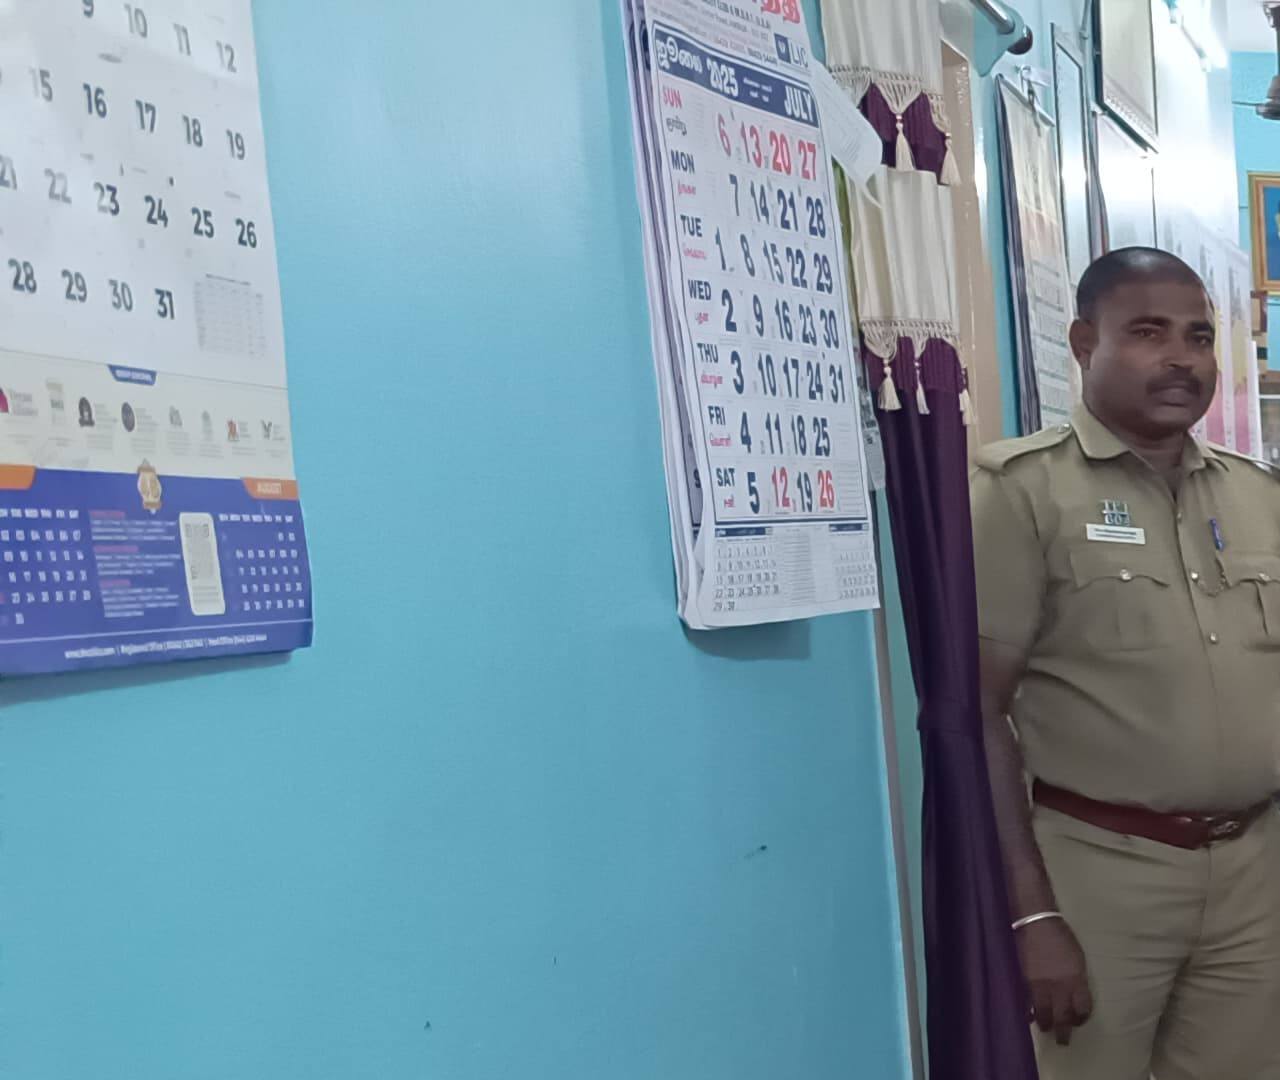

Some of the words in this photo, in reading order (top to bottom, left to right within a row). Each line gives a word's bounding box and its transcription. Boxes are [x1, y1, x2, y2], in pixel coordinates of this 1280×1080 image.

[789, 39, 808, 68] LIC
[83, 83, 107, 119] 16
[136, 100, 156, 134] 17
[183, 115, 202, 149] 18
[226, 128, 245, 160] 19
[707, 60, 738, 98] 2025
[784, 85, 814, 122] JULY
[663, 87, 682, 108] SUN
[718, 113, 731, 157] 6
[741, 121, 762, 168] 13
[770, 129, 792, 176] 20
[798, 140, 817, 181] 27
[680, 215, 703, 238] TUE
[715, 228, 727, 272] 1
[740, 233, 755, 278] 8
[763, 240, 784, 285] 15
[786, 246, 808, 289] 22
[813, 252, 833, 295] 29
[8, 260, 37, 294] 28
[62, 269, 87, 303] 29
[109, 279, 133, 312] 30
[155, 288, 175, 320] 31
[697, 343, 718, 363] THU
[731, 350, 744, 395] 3
[758, 354, 777, 397] 10
[783, 357, 799, 398] 17
[807, 362, 823, 401] 24
[829, 364, 846, 403] 31
[717, 467, 735, 486] SAT
[747, 472, 760, 514] 5
[772, 466, 791, 508] 12
[797, 471, 813, 512] 19
[817, 469, 835, 508] 26
